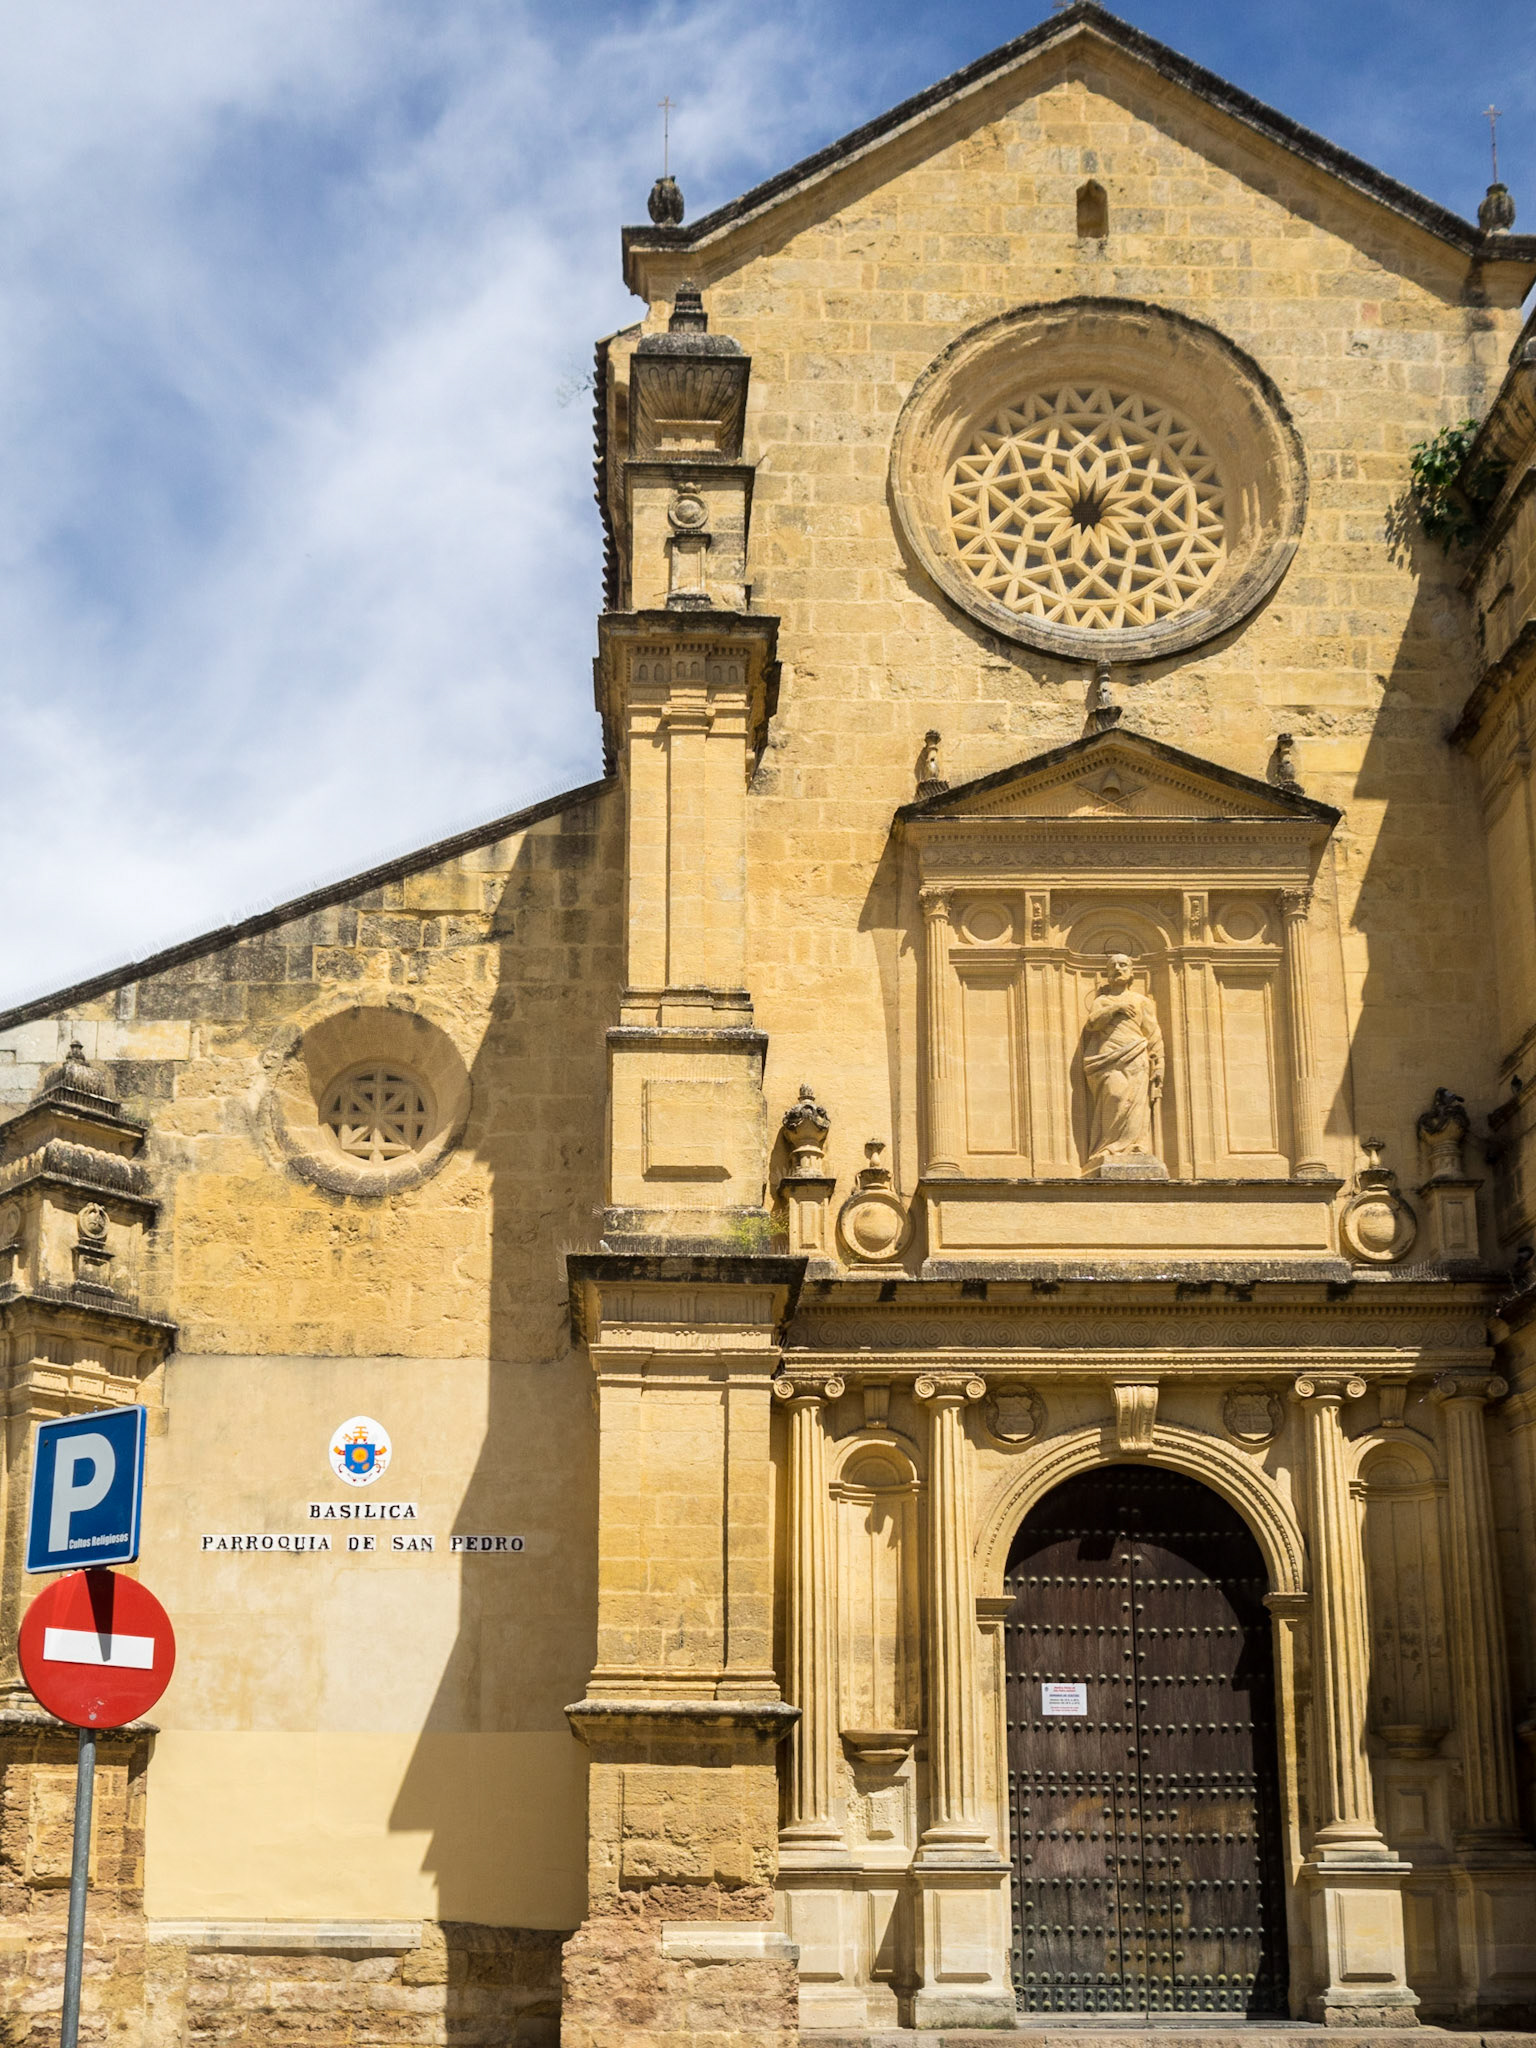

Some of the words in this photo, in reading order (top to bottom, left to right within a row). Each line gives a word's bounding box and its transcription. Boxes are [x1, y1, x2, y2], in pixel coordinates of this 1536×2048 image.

[48, 1433, 116, 1553] P
[310, 1504, 417, 1519] BASILICA
[69, 1538, 91, 1550] Cultos
[91, 1533, 129, 1547] Religiosos
[202, 1536, 331, 1551] PARROQUIA
[348, 1536, 376, 1551] DE
[393, 1536, 434, 1552] SAN
[451, 1536, 525, 1552] PEDRO
